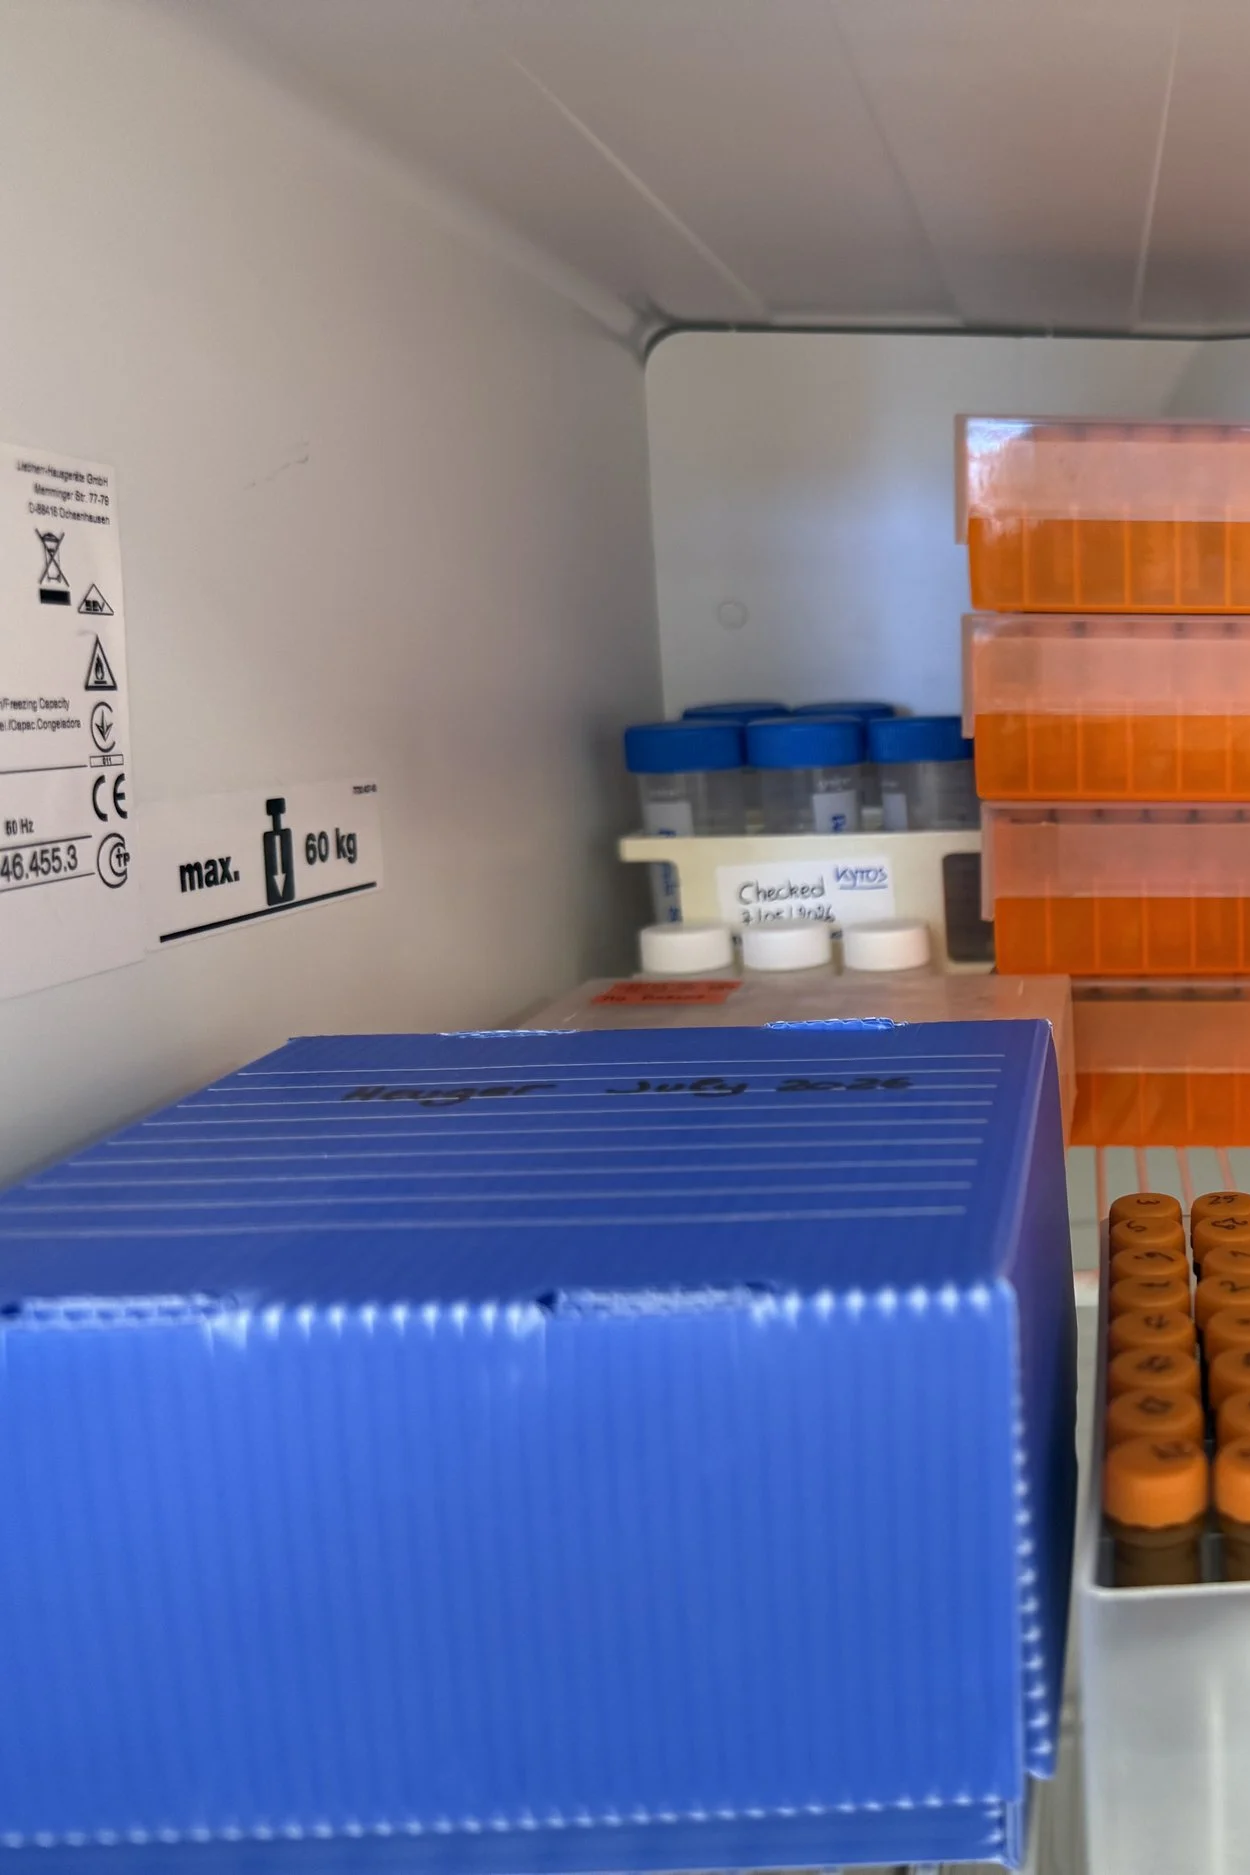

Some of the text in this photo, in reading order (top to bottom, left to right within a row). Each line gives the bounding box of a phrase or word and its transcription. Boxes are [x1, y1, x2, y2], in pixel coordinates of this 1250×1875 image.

[86, 473, 109, 487] GmbH
[89, 493, 110, 506] 77-79
[39, 697, 70, 711] Capacity
[20, 818, 34, 834] Hz
[179, 828, 357, 893] max. 60 kg
[738, 875, 825, 906] Checked
